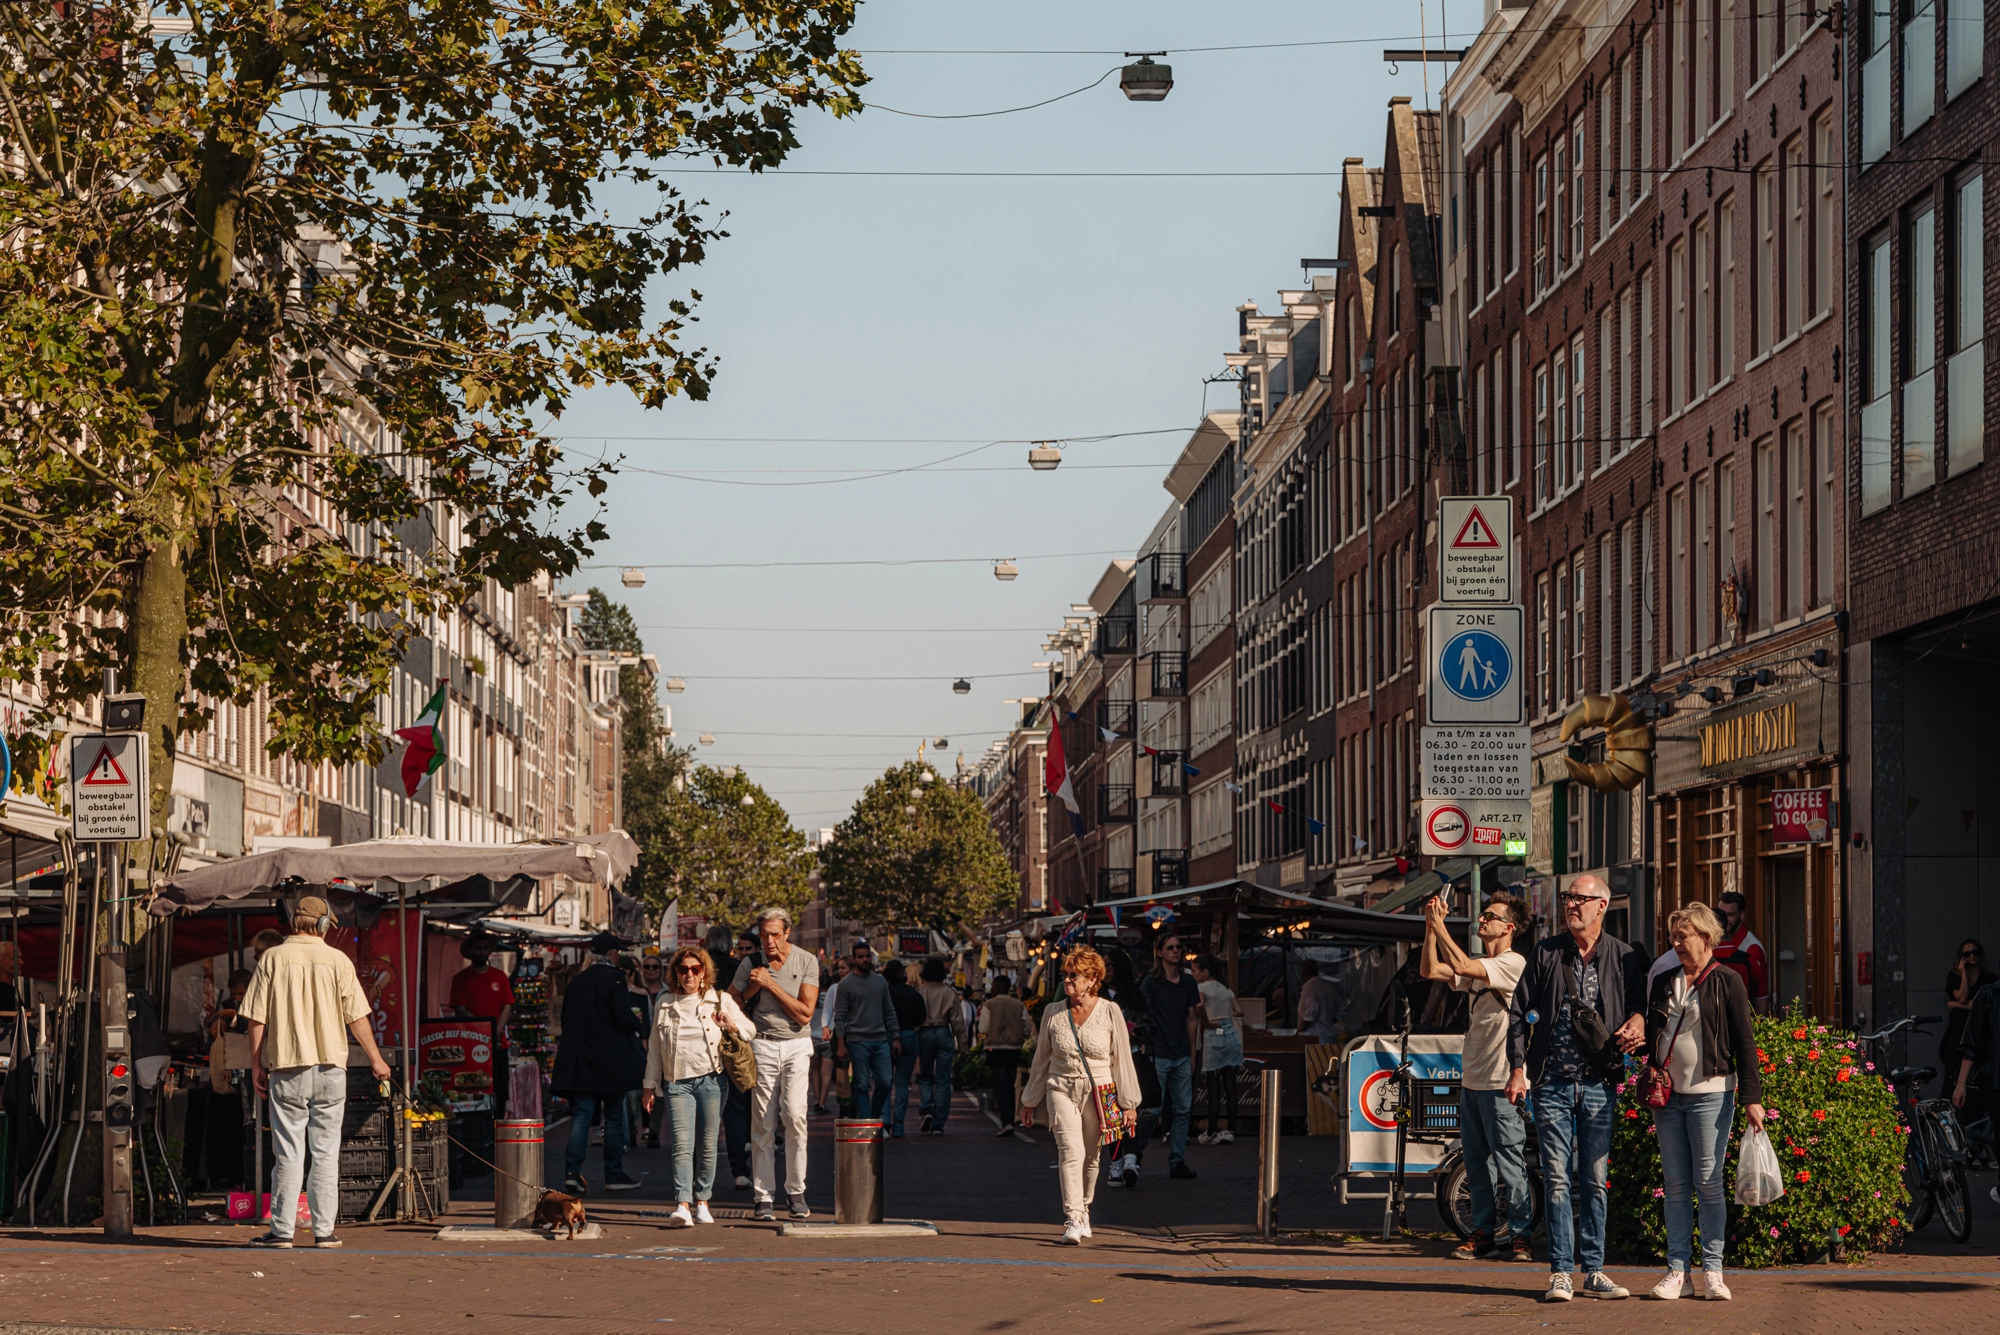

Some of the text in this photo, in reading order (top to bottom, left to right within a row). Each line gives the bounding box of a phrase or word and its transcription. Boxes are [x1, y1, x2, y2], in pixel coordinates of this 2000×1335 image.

[1448, 554, 1504, 563] beweegbaar
[1456, 565, 1495, 573] obstakel
[1446, 576, 1458, 585] bij
[1489, 576, 1505, 584] één
[1456, 588, 1495, 596] voertuig
[1456, 615, 1495, 625] ZONE
[1456, 729, 1475, 738] t/m
[1425, 741, 1458, 749] 06.30
[1471, 741, 1503, 749] 20.00
[1698, 718, 1735, 768] SIMON
[1433, 753, 1462, 761] laden
[1484, 753, 1518, 761] lossen
[1433, 765, 1494, 774] toegestaan
[1432, 776, 1464, 784] 06.30
[1477, 776, 1503, 784] 11.00
[1427, 787, 1456, 796] 16.30
[1469, 787, 1502, 796] 20.00
[1506, 788, 1525, 796] uur
[79, 792, 134, 801] beweegbaar
[1774, 791, 1823, 810] COFFEE
[88, 803, 126, 811] obstakel
[78, 814, 136, 824] bij groen één
[1775, 810, 1808, 826] TO GO
[89, 826, 126, 835] voertuig
[1500, 833, 1527, 841] A.P.V.
[421, 1030, 491, 1045] CLASSIC BEEF HOTDOGS
